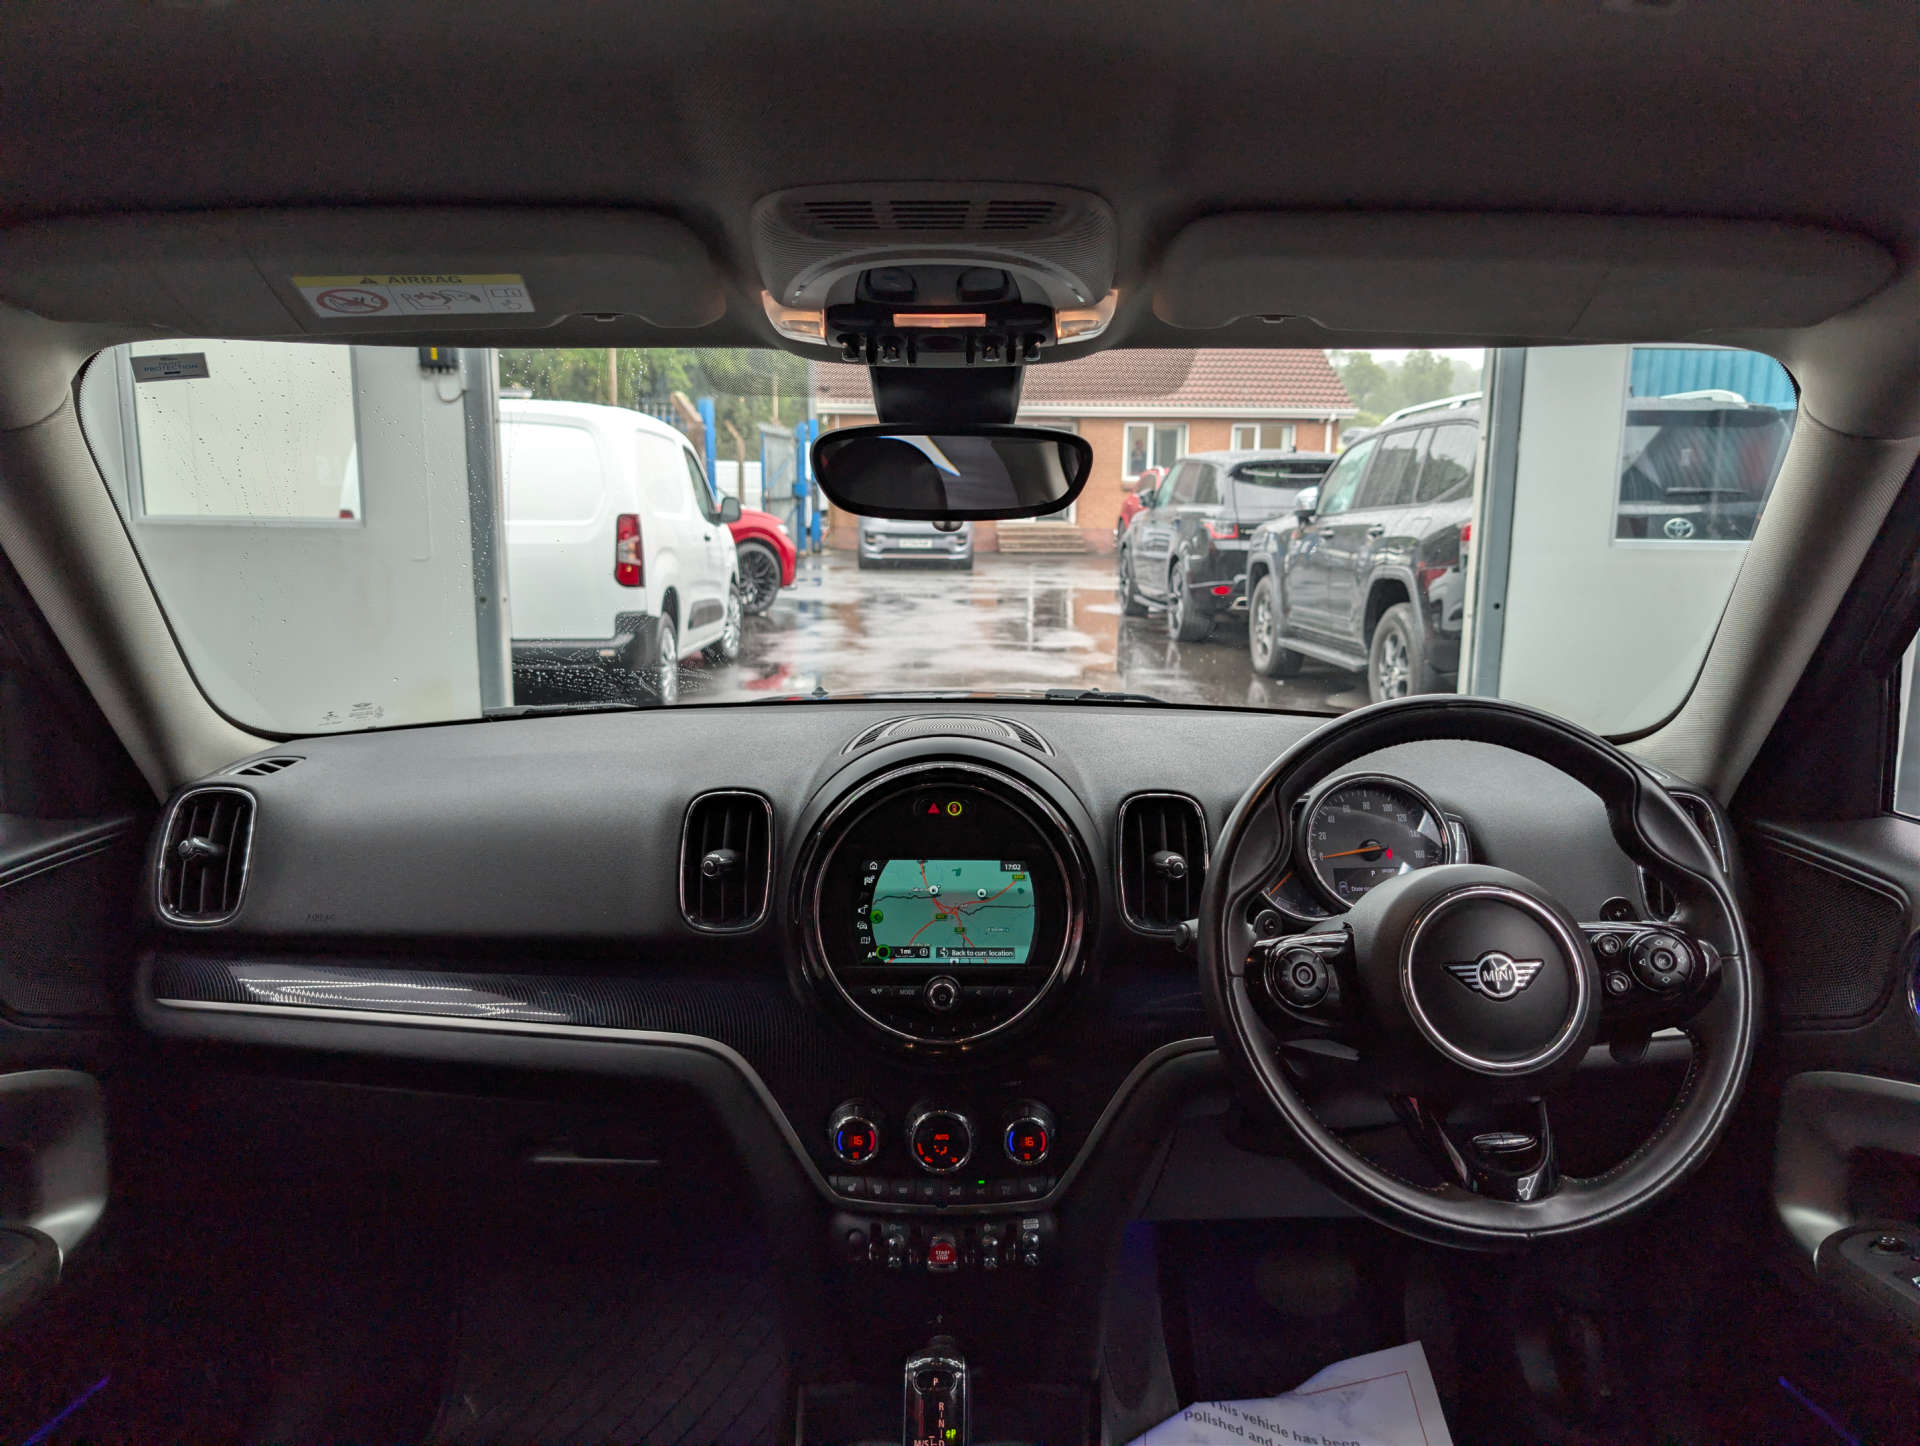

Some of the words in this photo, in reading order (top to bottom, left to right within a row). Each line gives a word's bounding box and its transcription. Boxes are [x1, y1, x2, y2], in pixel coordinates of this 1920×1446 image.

[388, 275, 462, 285] AIRBAG
[1318, 831, 1327, 841] 20
[1004, 863, 1021, 871] 17:02
[951, 949, 966, 957] Back
[1482, 969, 1513, 982] MINI
[1184, 1410, 1244, 1437] polished
[1248, 1431, 1273, 1446] and
[1241, 1411, 1289, 1438] vehicle
[1292, 1429, 1318, 1445] has
